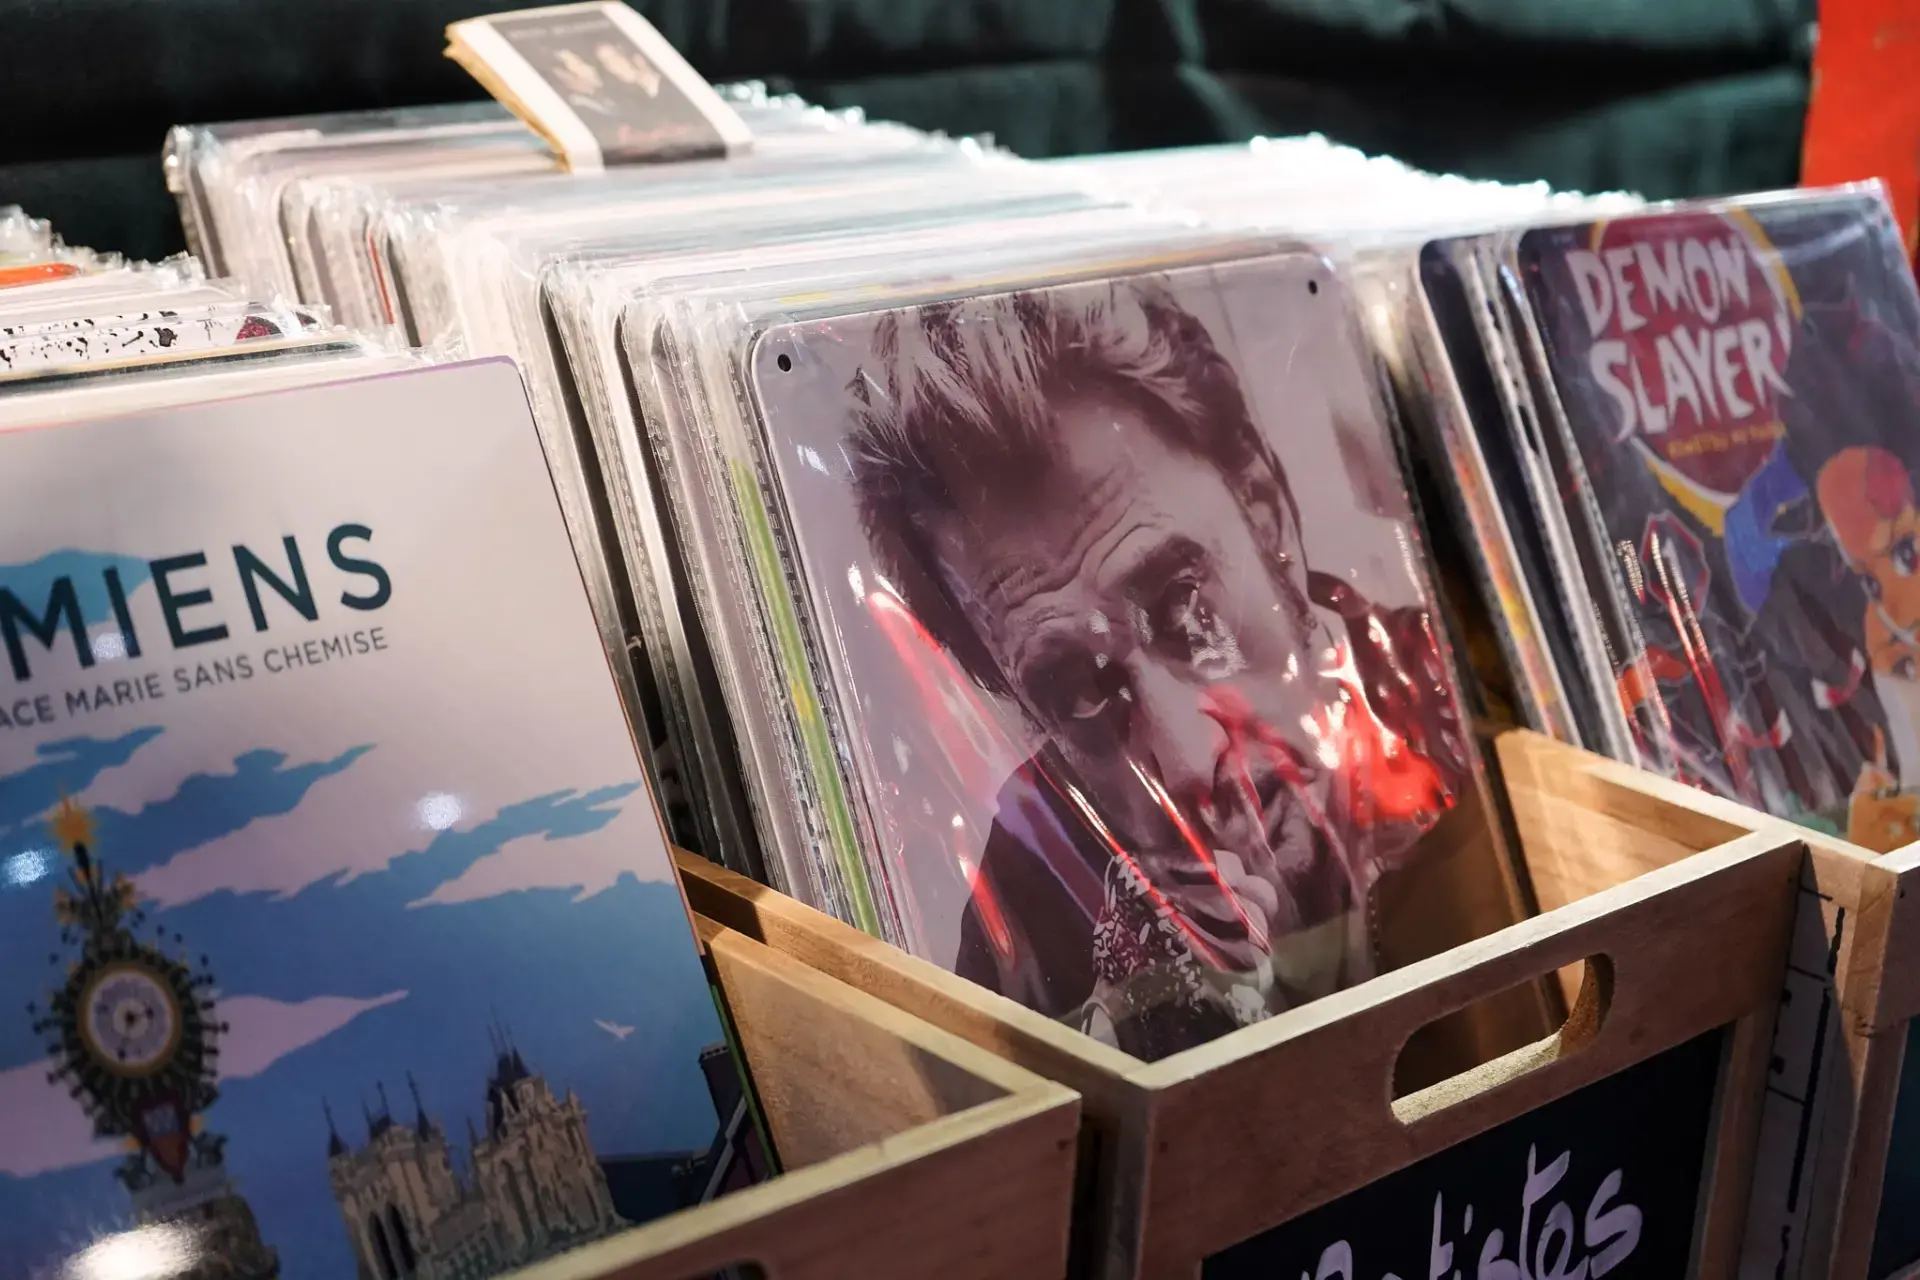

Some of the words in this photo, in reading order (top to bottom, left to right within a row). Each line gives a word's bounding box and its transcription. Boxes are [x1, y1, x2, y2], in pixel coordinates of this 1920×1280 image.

[1565, 234, 1751, 337] DEMON
[1588, 317, 1796, 444] SLAYER
[0, 522, 393, 682] MIENS
[64, 672, 165, 718] MARIE
[173, 655, 254, 693] SANS
[263, 626, 388, 673] CHEMISE
[1301, 1142, 1643, 1280] tistes
